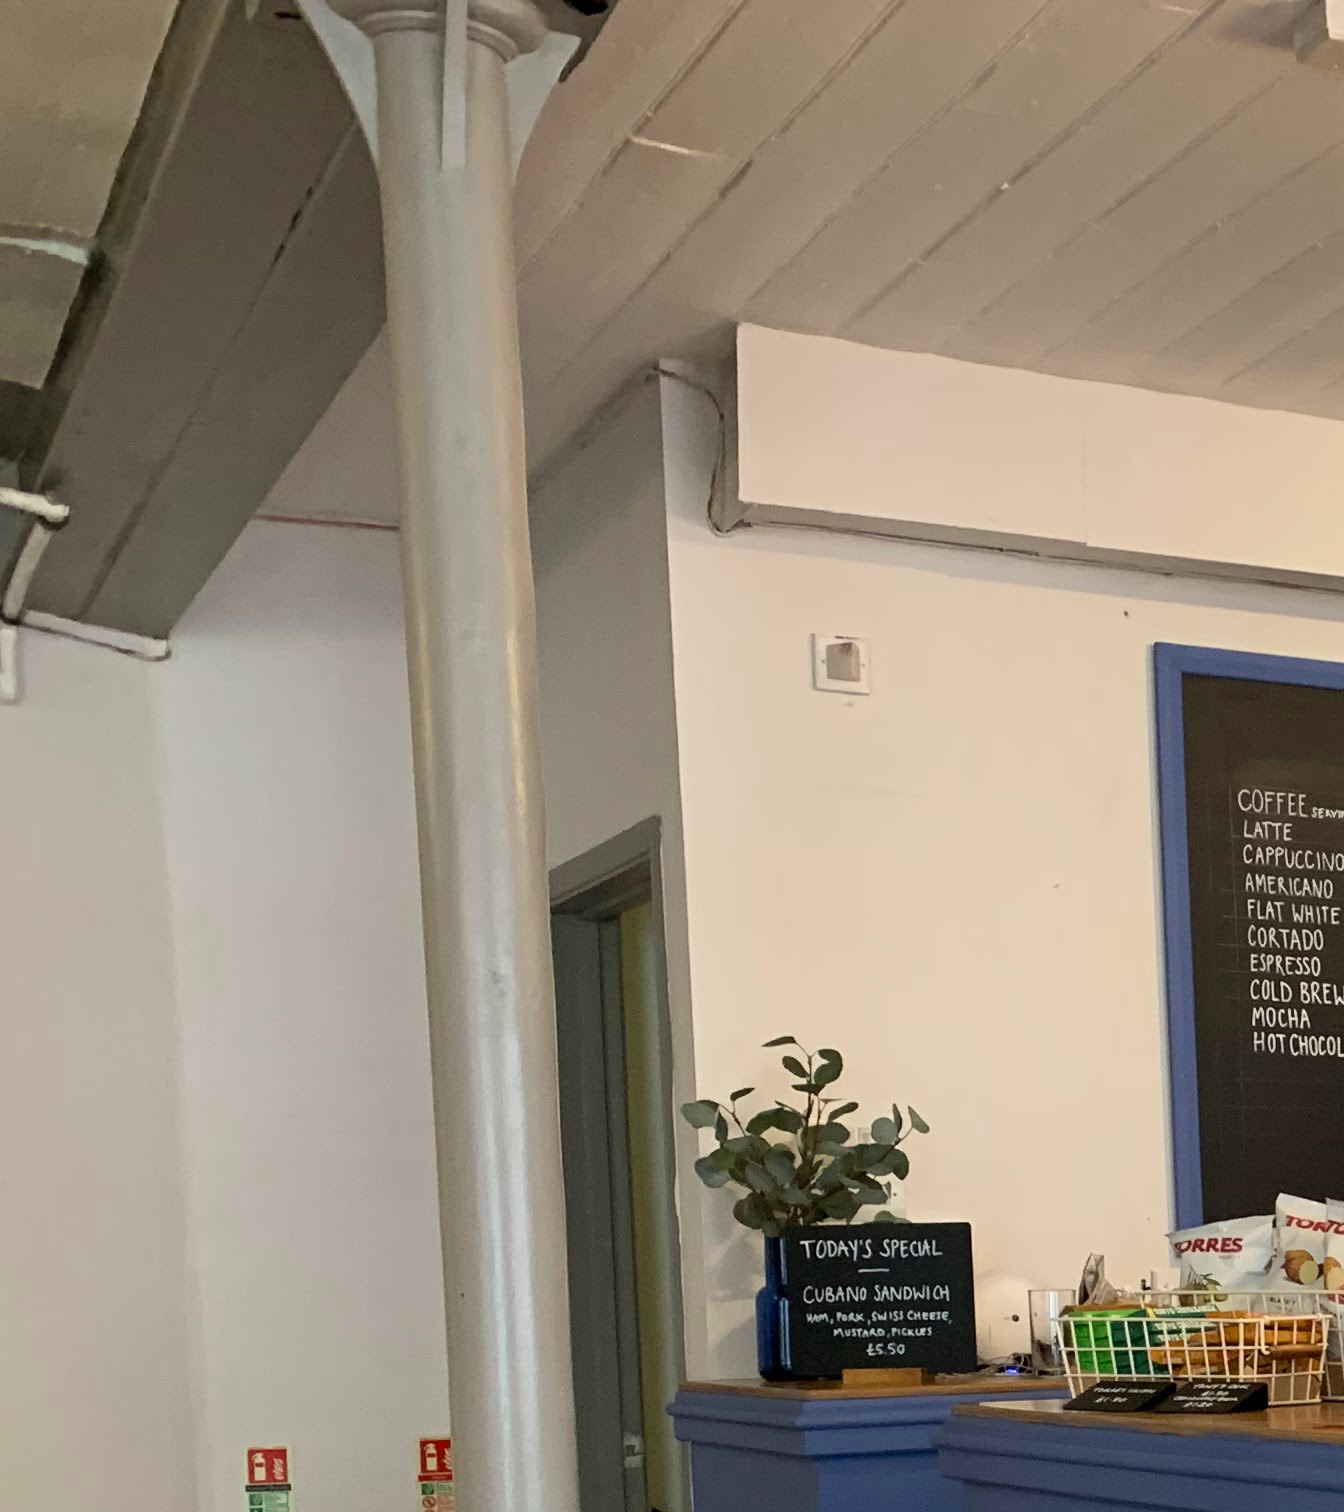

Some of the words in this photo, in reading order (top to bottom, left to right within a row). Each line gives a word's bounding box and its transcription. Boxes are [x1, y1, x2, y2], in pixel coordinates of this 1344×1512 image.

[1238, 789, 1308, 818] COFFEE
[1243, 819, 1293, 841] LATTE
[1243, 844, 1344, 871] CAPPUCCINO
[1245, 873, 1334, 899] AMERICANO
[1247, 899, 1285, 922] FLAT
[1291, 903, 1341, 925] WHITE
[1247, 925, 1324, 951] CORTADO
[1250, 954, 1321, 977] ESPRESSO
[1250, 979, 1293, 1002] COLD
[1251, 1007, 1311, 1029] MOCHA
[1253, 1031, 1286, 1053] HOT
[799, 1239, 872, 1262] TODAY'S
[879, 1239, 943, 1258] SPECIAL
[803, 1286, 867, 1304] CUBANO
[873, 1284, 951, 1302] SANDWICH
[872, 1310, 904, 1321] SWISS
[907, 1310, 952, 1325] CHEESE,
[891, 1327, 932, 1337] PICKLES
[866, 1343, 906, 1356] £5.50
